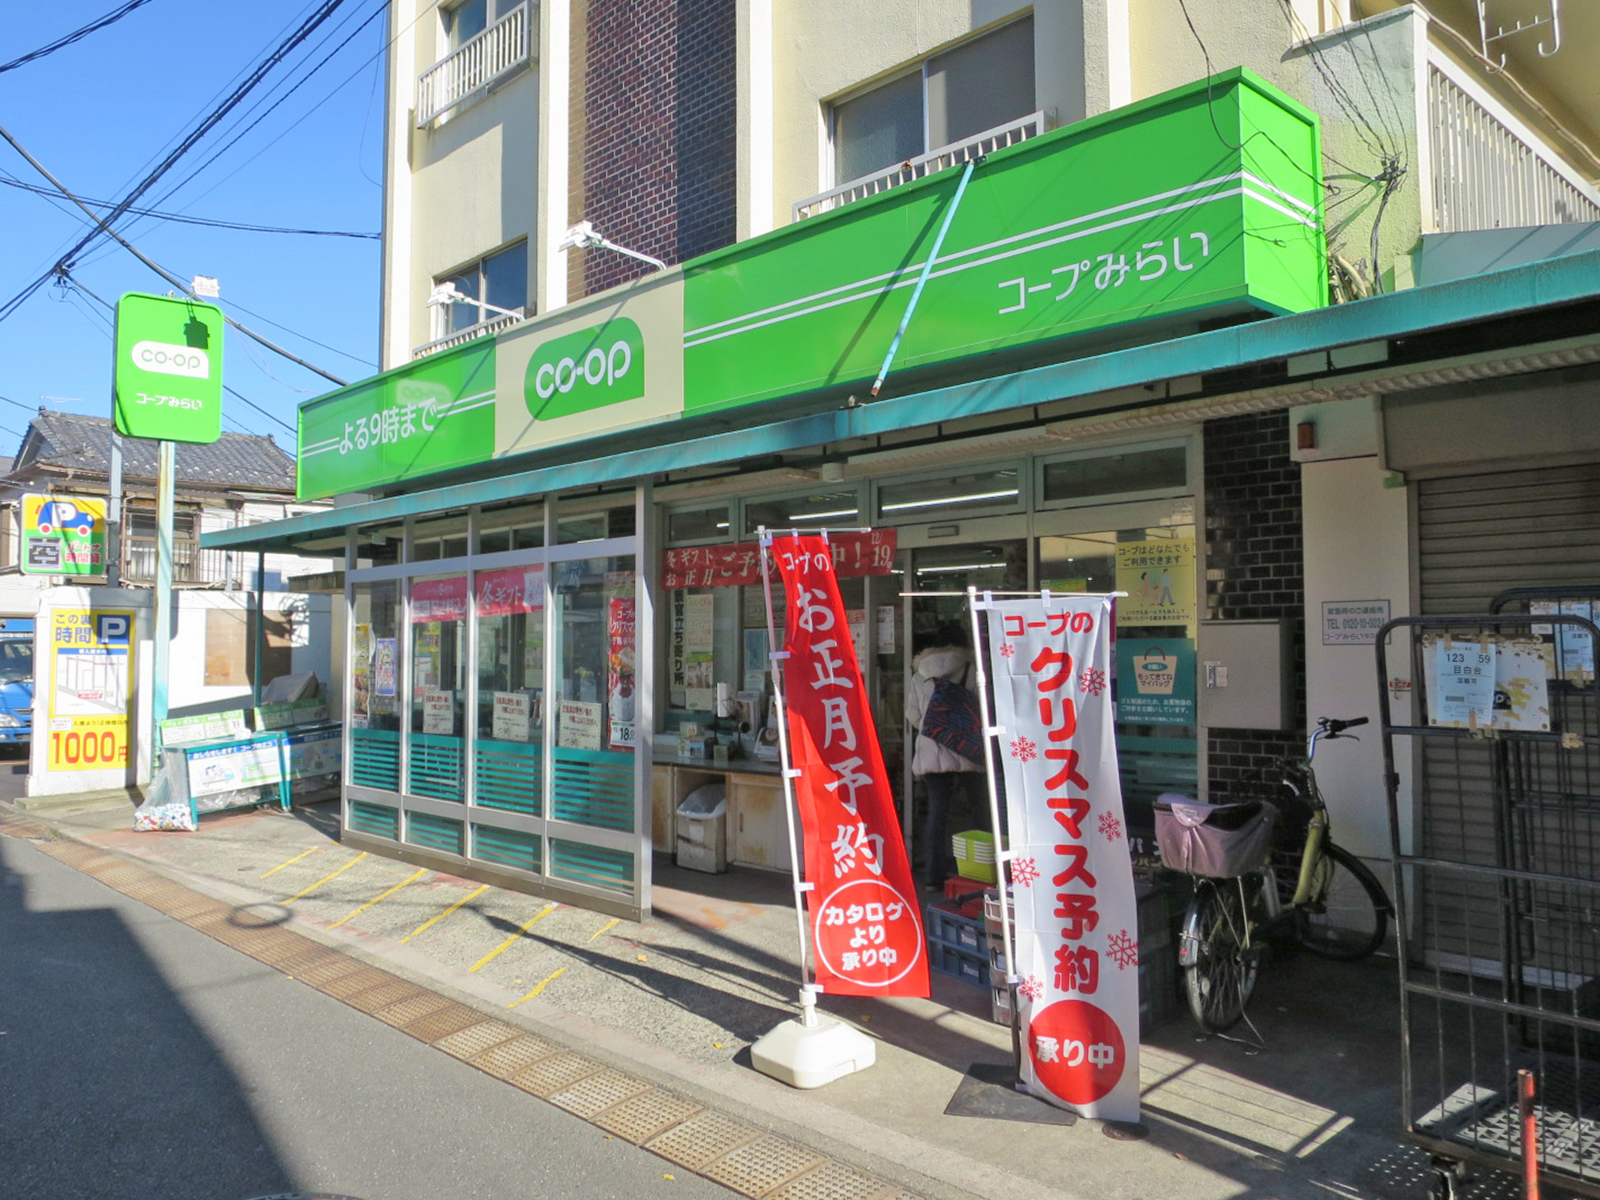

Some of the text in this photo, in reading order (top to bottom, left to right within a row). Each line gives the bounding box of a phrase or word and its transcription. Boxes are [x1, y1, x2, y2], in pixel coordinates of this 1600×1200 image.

[998, 231, 1209, 315] コープみらい
[136, 392, 203, 410] コープみらい
[338, 397, 437, 456] よる9時まで
[667, 550, 713, 568] 冬ギフト
[1118, 544, 1190, 556] コープはどなたでも
[1123, 555, 1181, 567] ご利用できます
[665, 568, 714, 586] お正月
[1004, 611, 1095, 637] コープの
[1326, 618, 1340, 630] TEL
[55, 627, 92, 643] 時間
[1478, 654, 1491, 664] 59
[1453, 665, 1482, 675] 目白台
[1141, 680, 1171, 688] マイバッグ
[796, 582, 885, 879] お正月予約
[1030, 646, 1101, 995] クリスマス予約
[825, 901, 905, 926] カタログ
[849, 924, 885, 948] より
[841, 946, 897, 971] 承り中
[1035, 1035, 1114, 1070] 承り中
